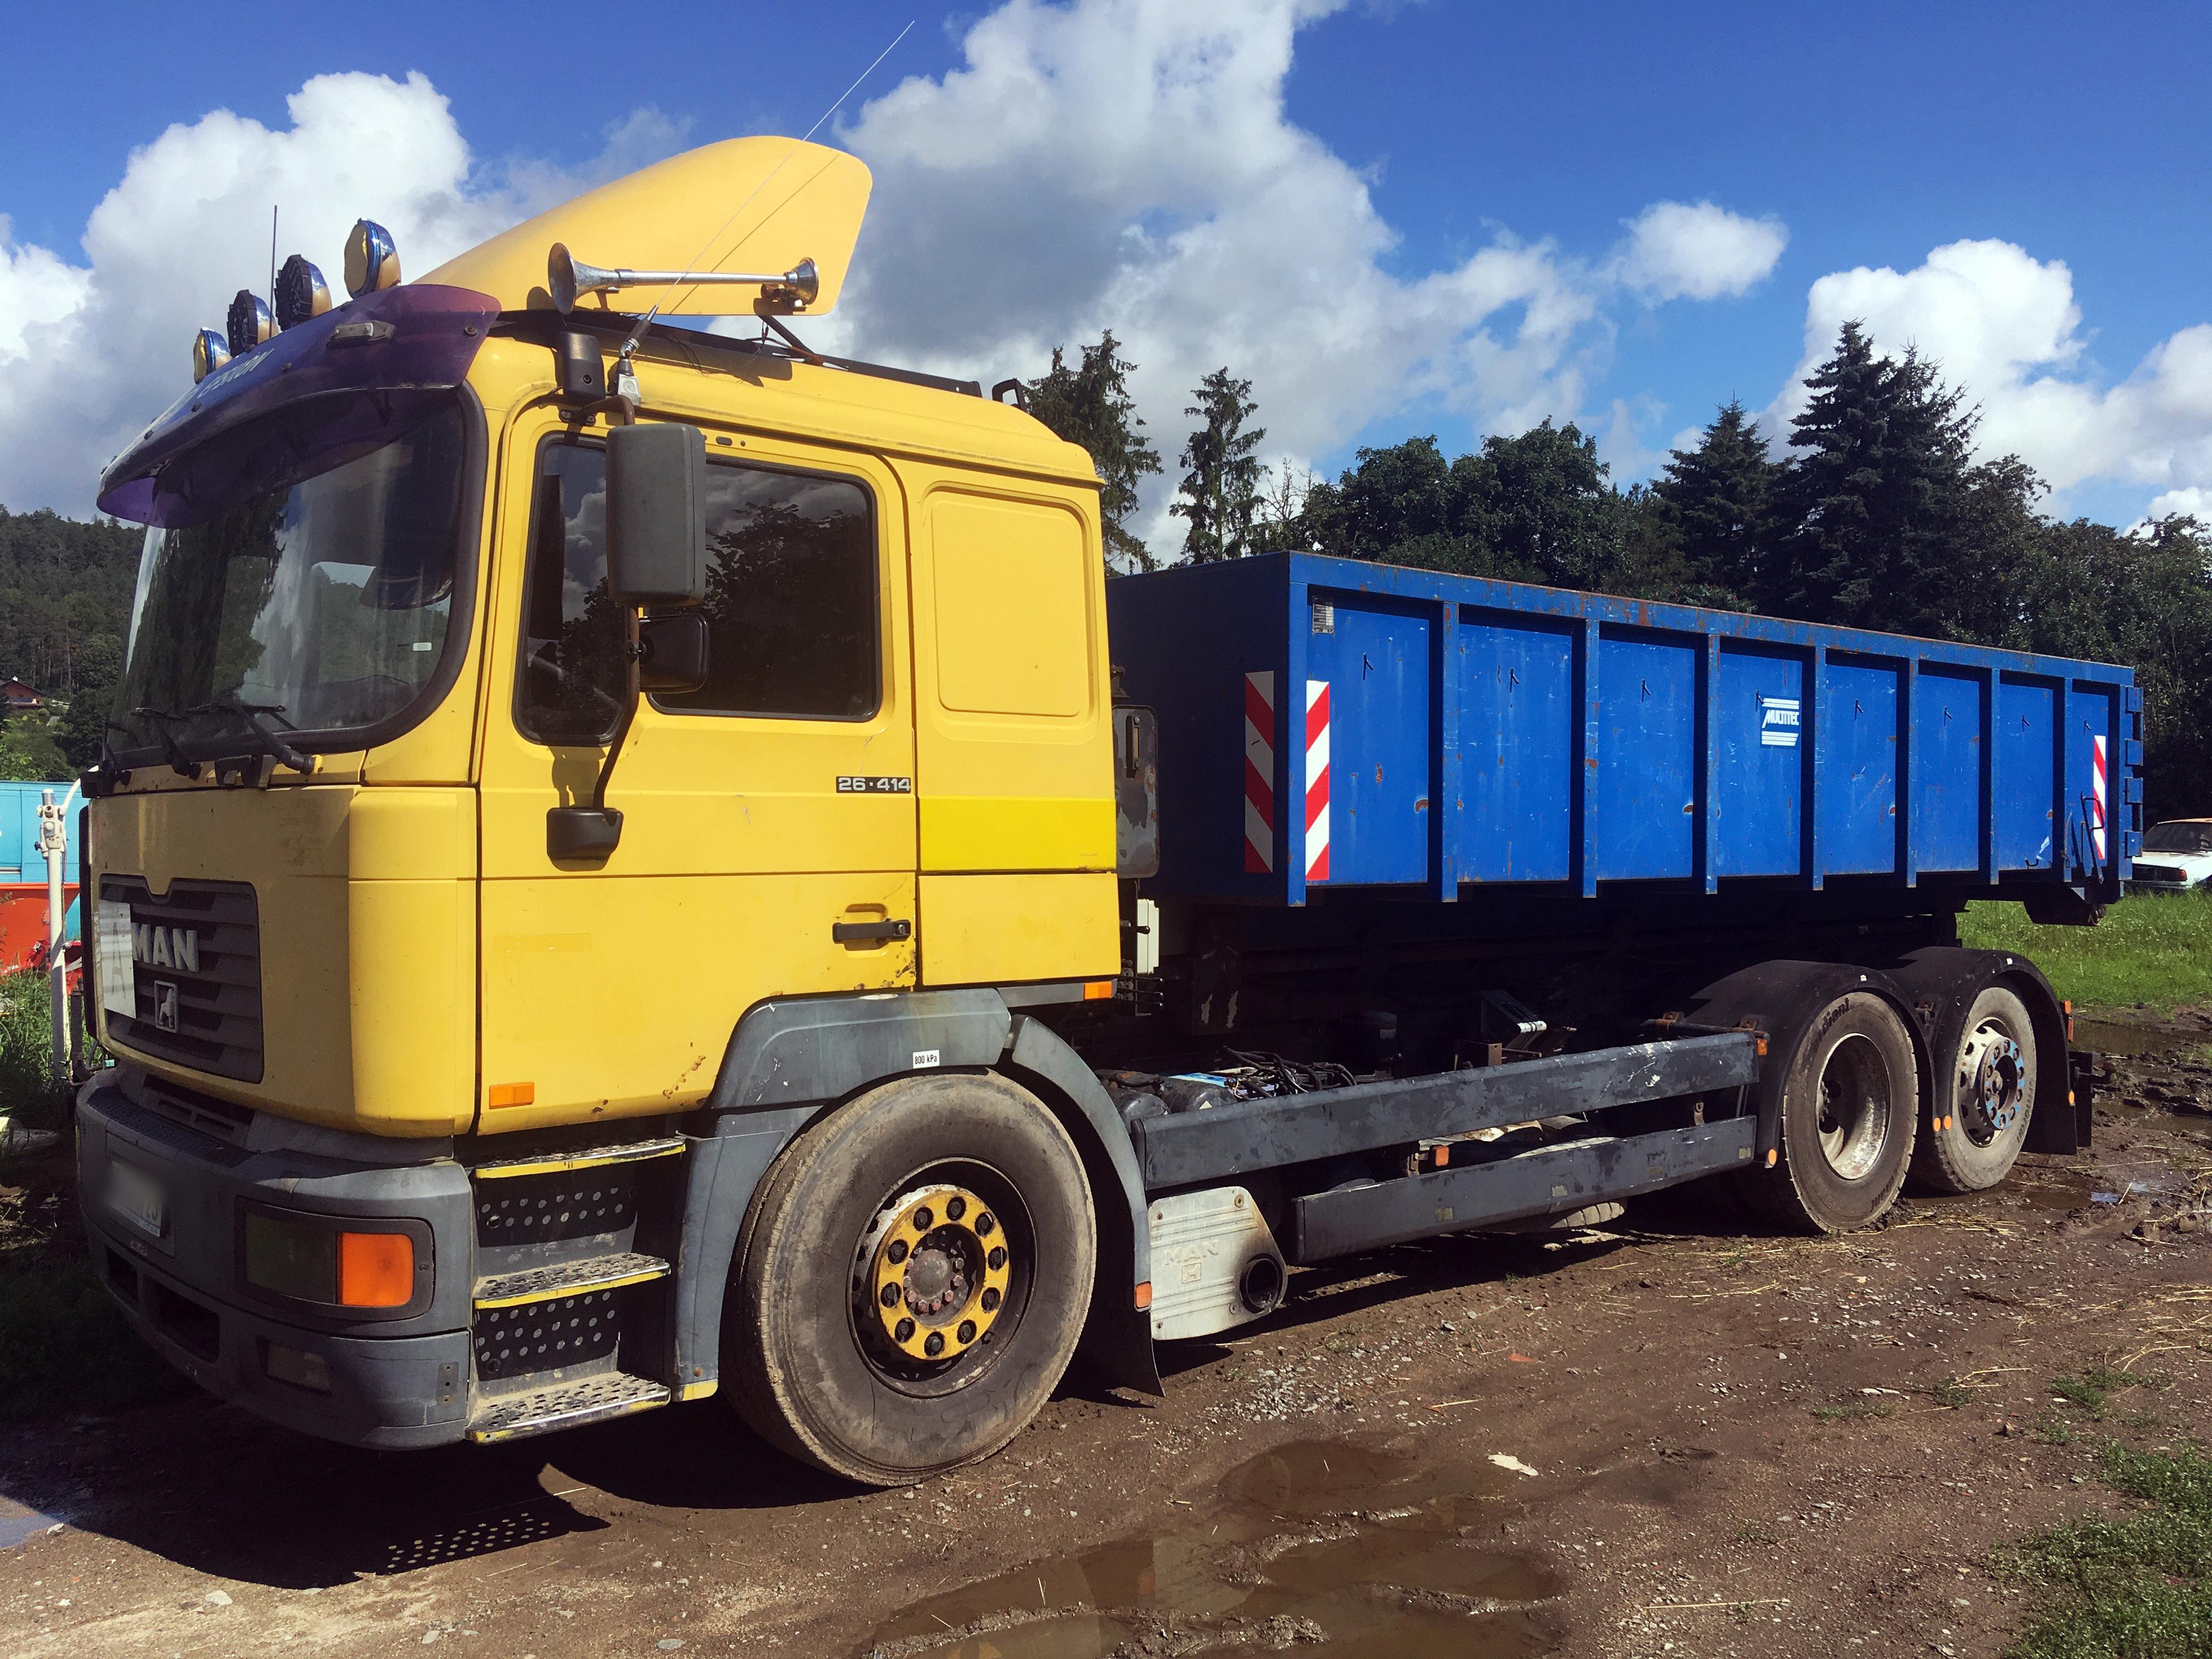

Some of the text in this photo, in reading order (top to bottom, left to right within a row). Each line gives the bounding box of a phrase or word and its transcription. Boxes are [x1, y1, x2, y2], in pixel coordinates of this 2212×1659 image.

[1762, 709, 1799, 729] MULTITEC
[132, 922, 200, 972] MAN
[915, 1054, 937, 1065] 800 kPa
[1164, 1239, 1220, 1266] MAN
